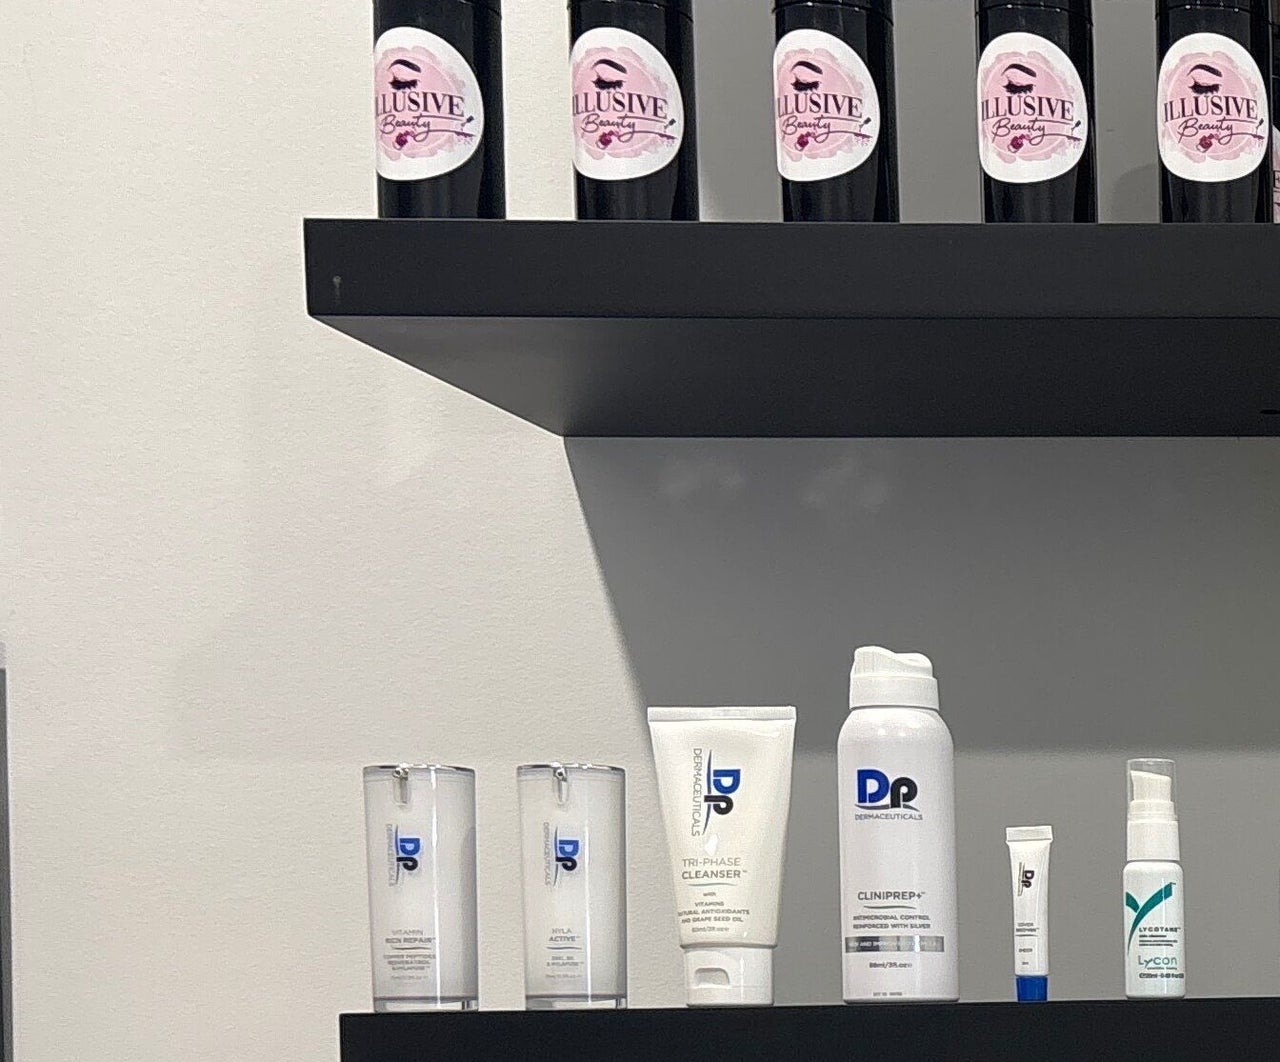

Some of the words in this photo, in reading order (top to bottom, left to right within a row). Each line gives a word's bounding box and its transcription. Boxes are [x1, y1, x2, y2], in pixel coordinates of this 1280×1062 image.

[375, 91, 465, 117] LLUSIVE
[777, 93, 863, 118] LLUSIVE
[982, 95, 1073, 122] ILLUSIVE
[1164, 95, 1258, 123] ILLUSIVE
[855, 813, 923, 821] DERMACEUTICALS
[682, 857, 741, 867] TRI-PHASE
[1138, 955, 1177, 968] Lycon
